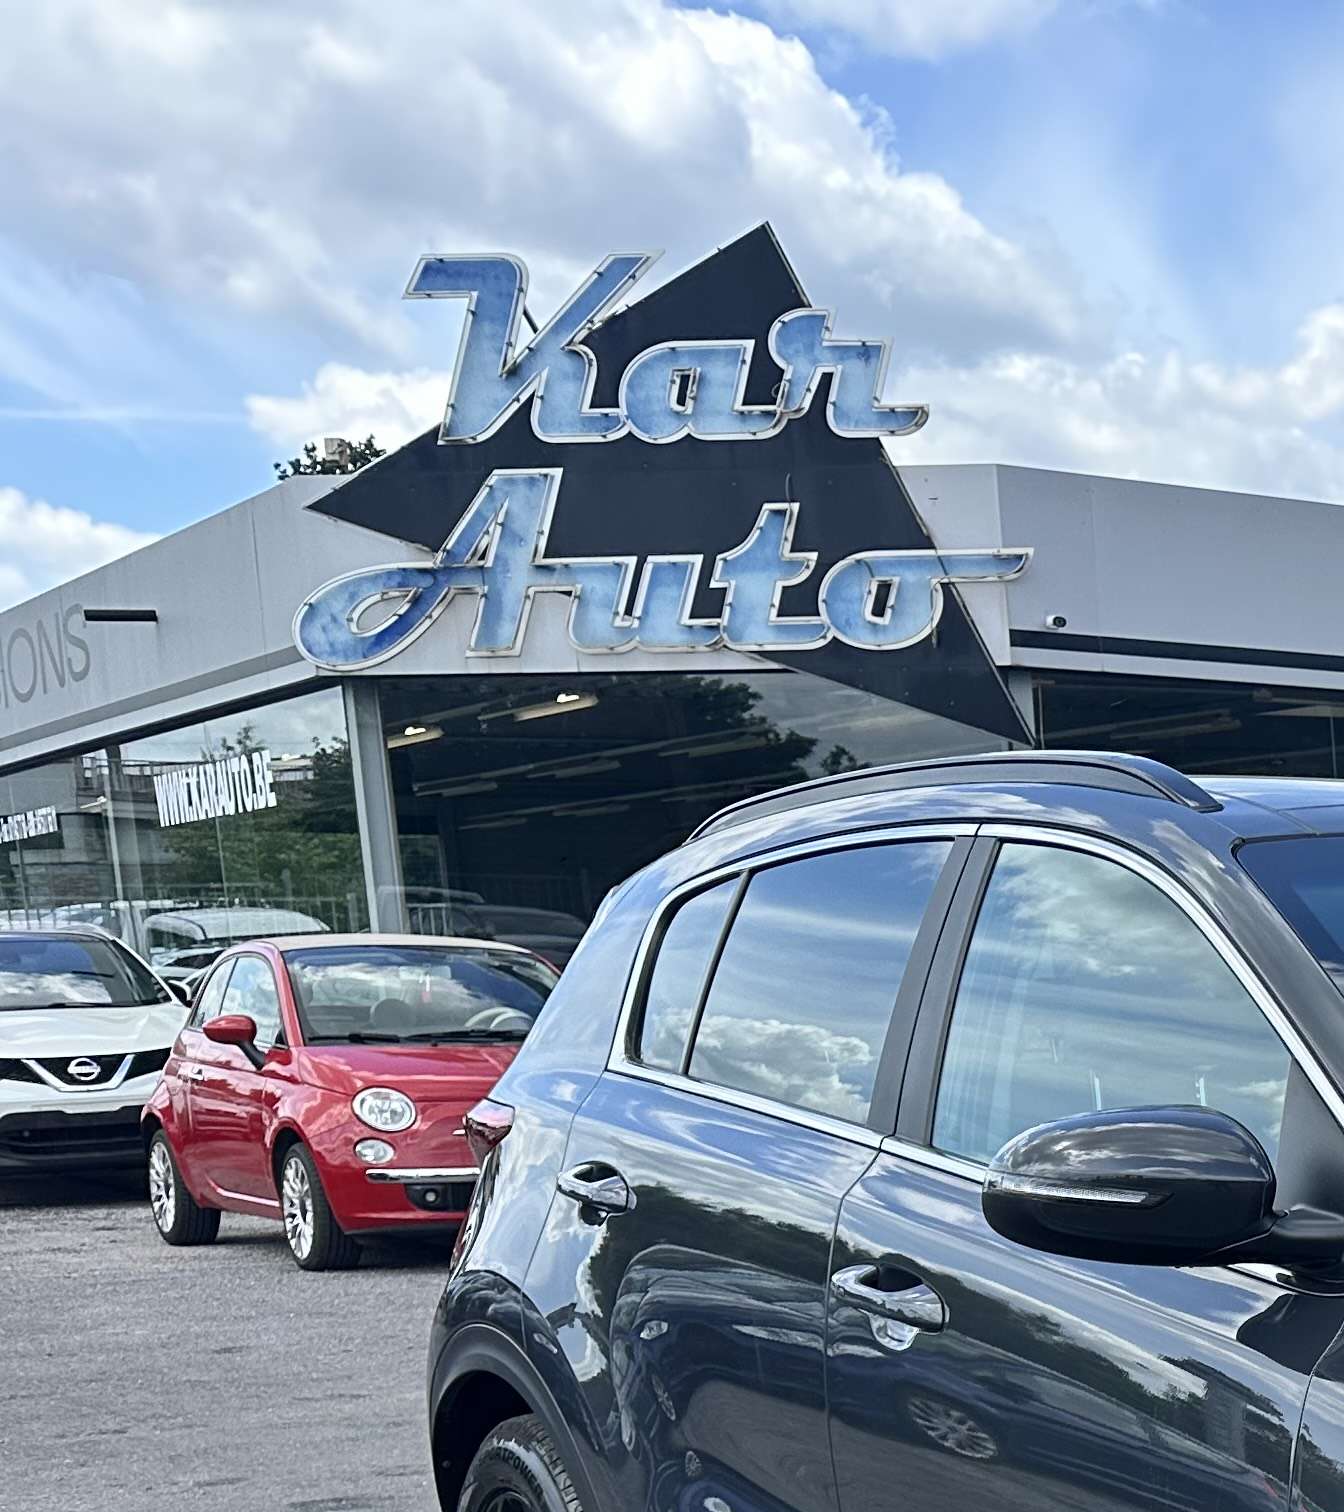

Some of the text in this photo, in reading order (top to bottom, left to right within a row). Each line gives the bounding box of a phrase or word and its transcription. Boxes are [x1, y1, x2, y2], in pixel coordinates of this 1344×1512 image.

[402, 249, 930, 445] Kar
[292, 467, 1034, 671] Auto
[0, 603, 91, 708] IONS
[153, 749, 278, 828] WWW.KARAUTO.BE
